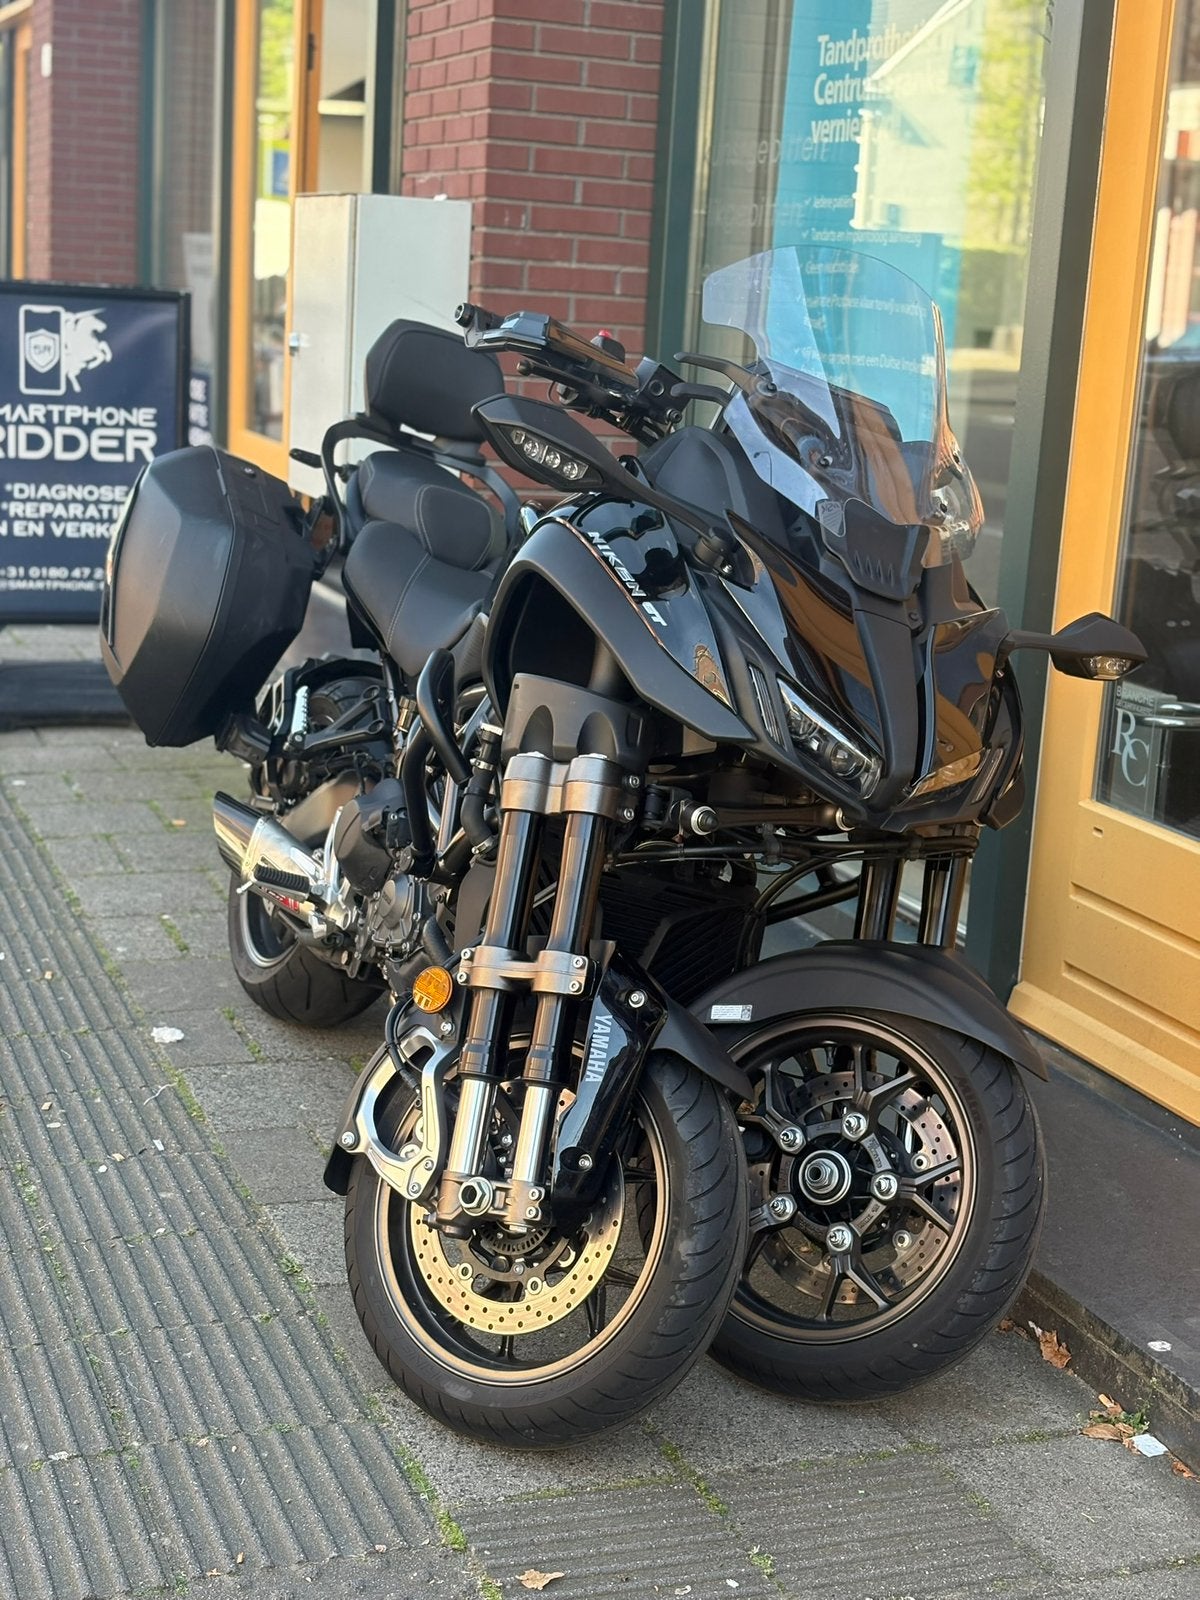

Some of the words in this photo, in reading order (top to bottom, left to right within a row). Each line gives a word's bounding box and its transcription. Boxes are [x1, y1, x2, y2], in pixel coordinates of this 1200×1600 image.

[811, 109, 861, 143] vernie
[0, 425, 157, 463] IDDER
[13, 520, 45, 537] EN
[587, 531, 647, 597] NIKEN
[585, 1014, 613, 1083] YAMAHA
